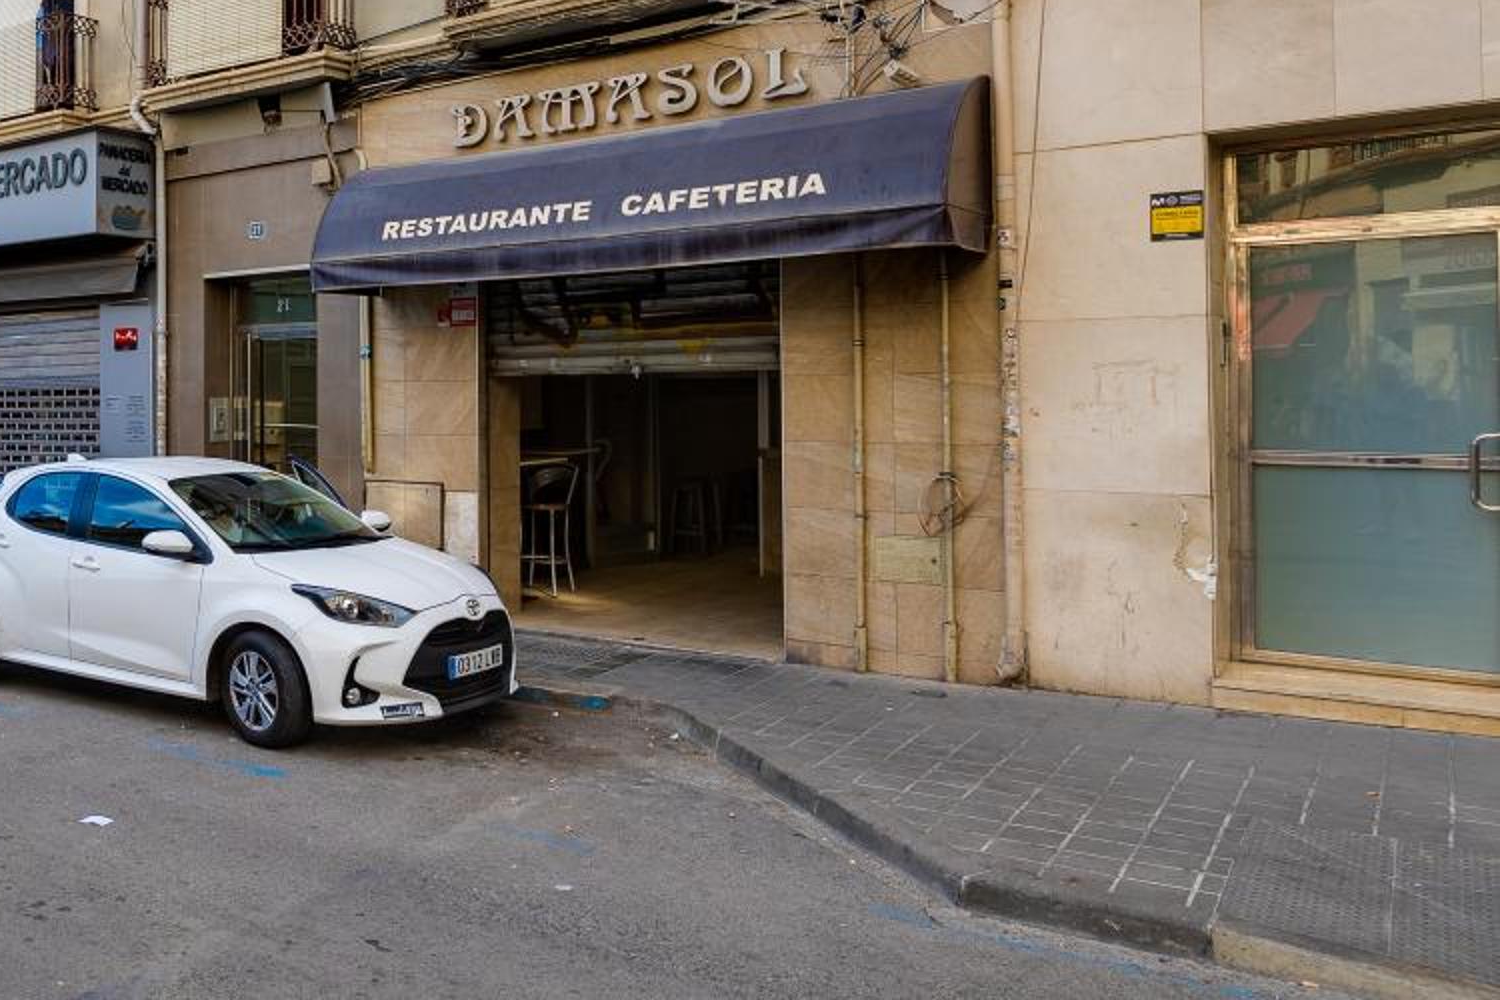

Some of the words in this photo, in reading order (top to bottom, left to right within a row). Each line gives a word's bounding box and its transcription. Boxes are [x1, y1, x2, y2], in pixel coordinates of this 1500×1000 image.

[452, 47, 810, 149] DAMASOL
[381, 199, 593, 242] RESTAURANTE
[620, 172, 827, 218] CAFETERIA
